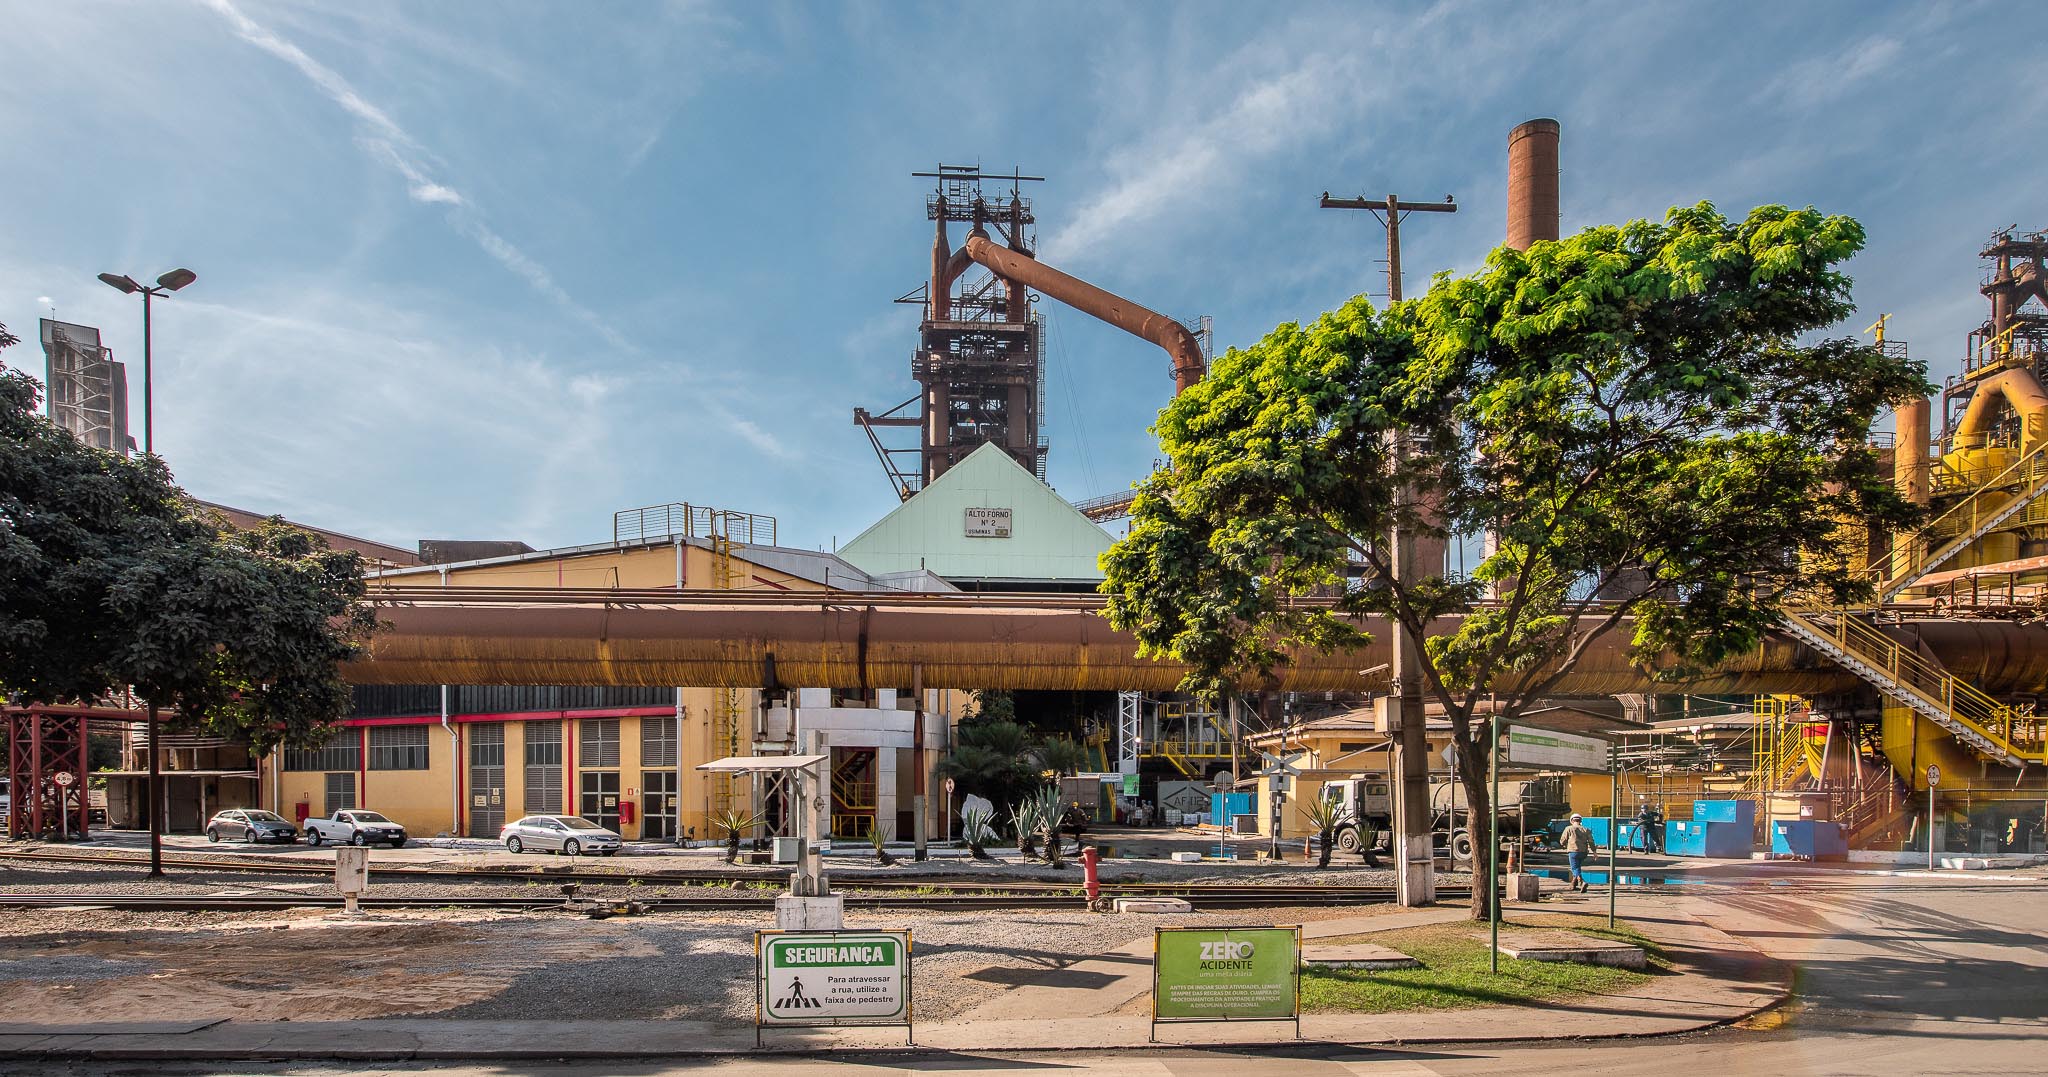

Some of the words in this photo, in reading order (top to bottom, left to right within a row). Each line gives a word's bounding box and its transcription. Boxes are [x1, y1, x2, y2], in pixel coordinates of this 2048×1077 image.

[786, 946, 884, 964] SEGURANÇA
[1200, 942, 1254, 959] ZERO
[1200, 960, 1253, 970] ACIDENTE
[858, 996, 894, 1004] pedestre
